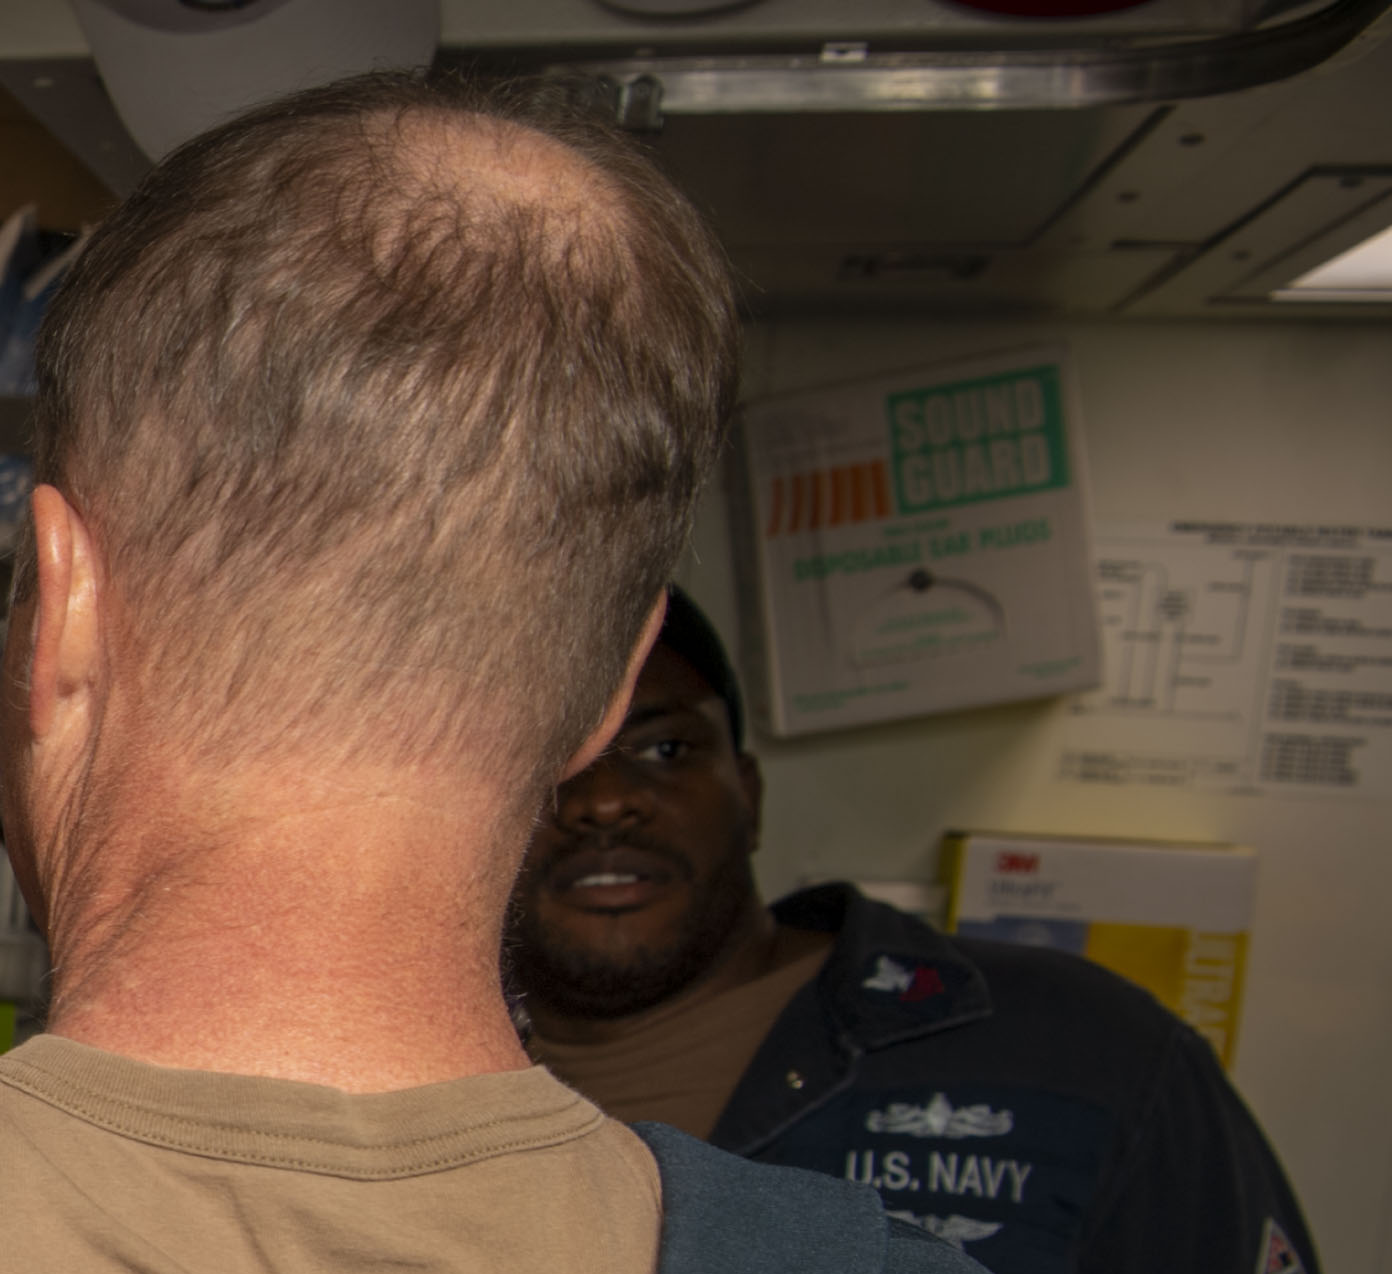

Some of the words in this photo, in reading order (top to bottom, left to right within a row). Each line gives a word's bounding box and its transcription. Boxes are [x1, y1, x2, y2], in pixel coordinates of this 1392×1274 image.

[896, 377, 1048, 455] SOUND
[902, 433, 1055, 508] GUARD
[844, 1150, 920, 1192] U.S.
[928, 1151, 1032, 1203] NAVY
